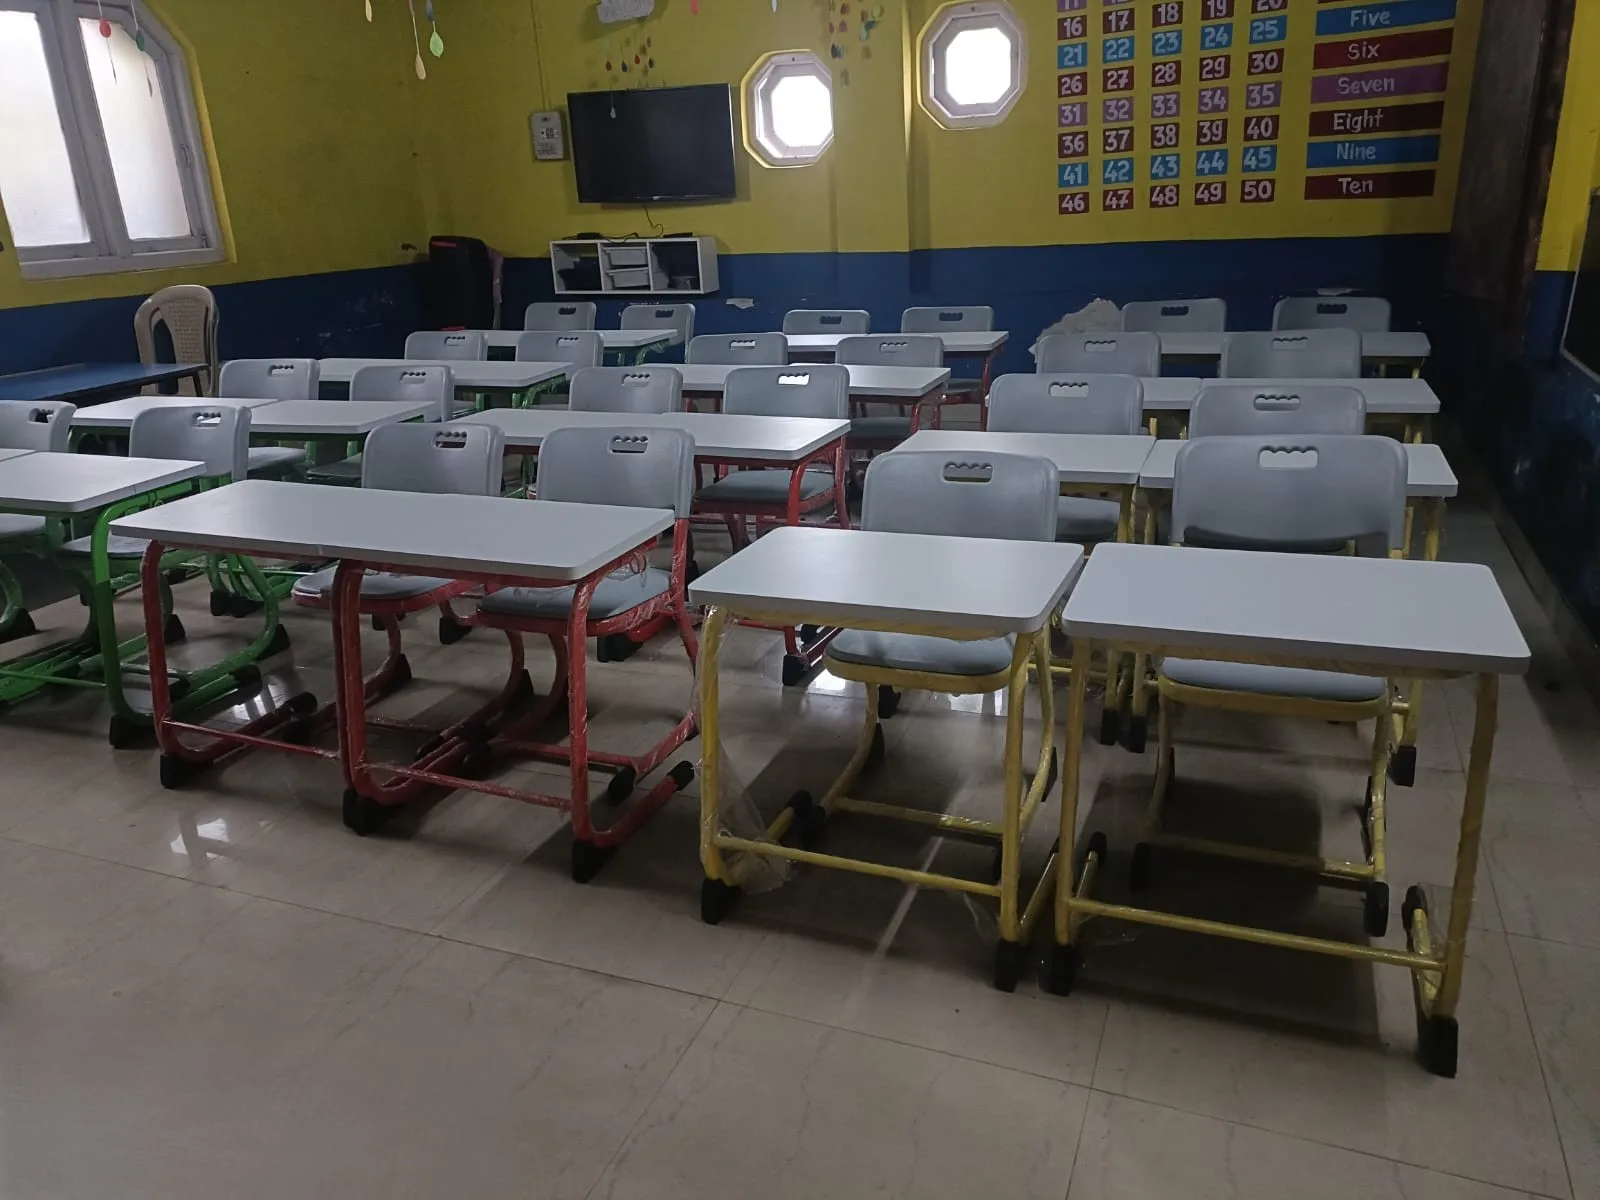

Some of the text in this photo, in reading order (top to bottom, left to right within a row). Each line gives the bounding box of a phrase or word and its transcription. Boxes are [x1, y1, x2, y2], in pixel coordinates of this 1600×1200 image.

[1064, 17, 1082, 37] 16
[1108, 10, 1129, 31] 17
[1158, 2, 1179, 24] 18
[1208, 0, 1227, 17] 19
[1350, 10, 1390, 27] Five
[1064, 20, 1278, 65] 21 22 23 24 25
[1348, 41, 1380, 59] Six
[1062, 52, 1278, 95] 26 27 28 29 30
[1337, 76, 1395, 94] Seven
[1062, 84, 1275, 124] 31 32 33 34 35
[1062, 117, 1272, 154] 36 37 38 39 40
[1333, 108, 1383, 133] Eight
[1064, 147, 1271, 184] 41 42 43 44 45
[1337, 143, 1376, 160] Nine
[1062, 181, 1272, 212] 46 47 48 49 50
[1338, 177, 1373, 194] Ten
